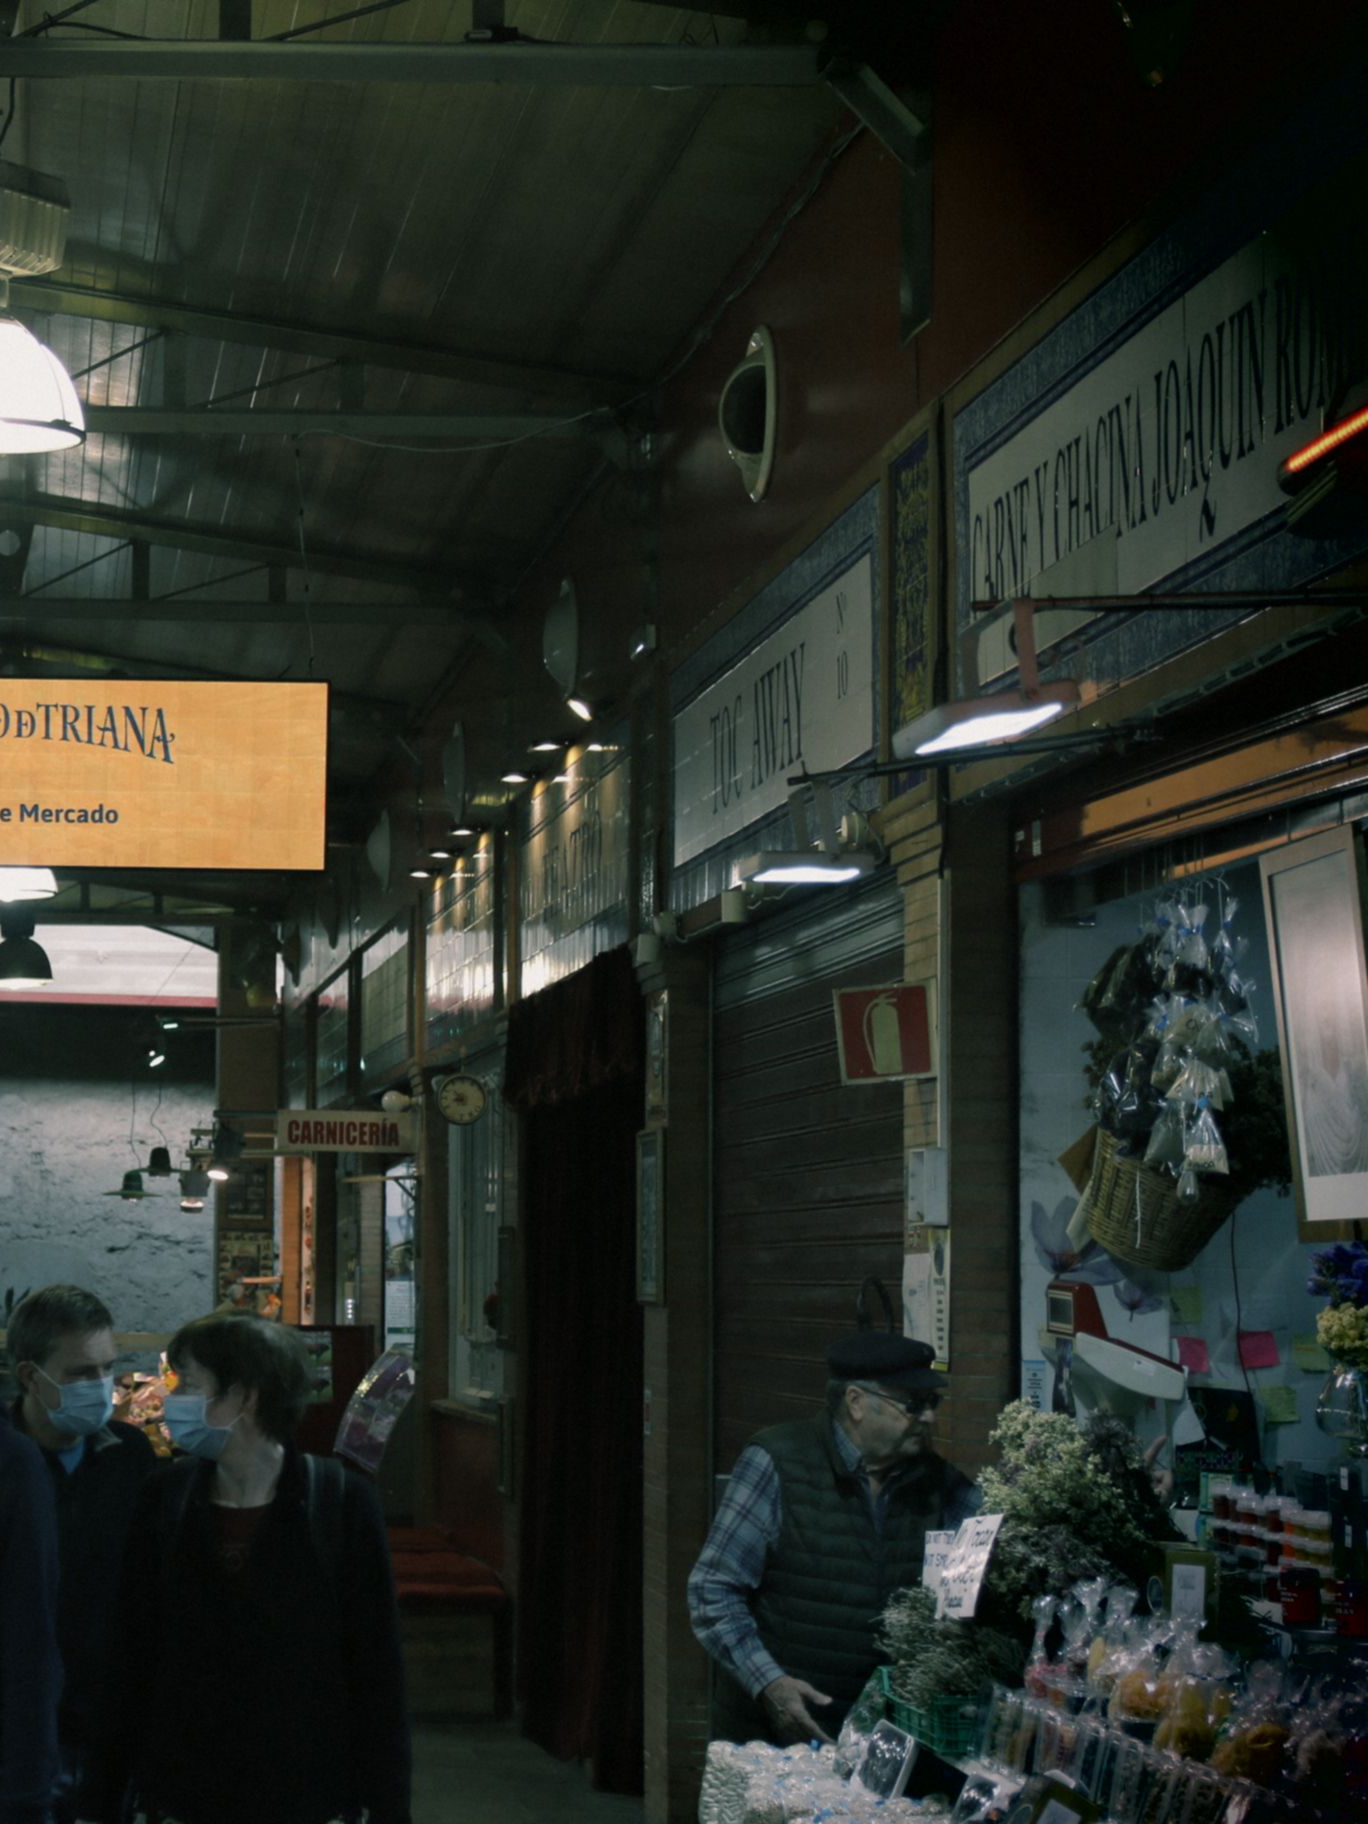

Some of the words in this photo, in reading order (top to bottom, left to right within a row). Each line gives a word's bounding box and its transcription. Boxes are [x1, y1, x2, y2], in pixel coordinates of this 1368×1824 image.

[1034, 460, 1049, 573] Y
[1054, 384, 1147, 562] CHACINA
[1152, 289, 1268, 543] JOAQUIN
[836, 651, 849, 700] 10
[35, 701, 176, 764] TRIANA
[750, 641, 806, 790] AWAY
[19, 803, 120, 824] Mercado
[287, 1118, 400, 1147] CARNICERÍA
